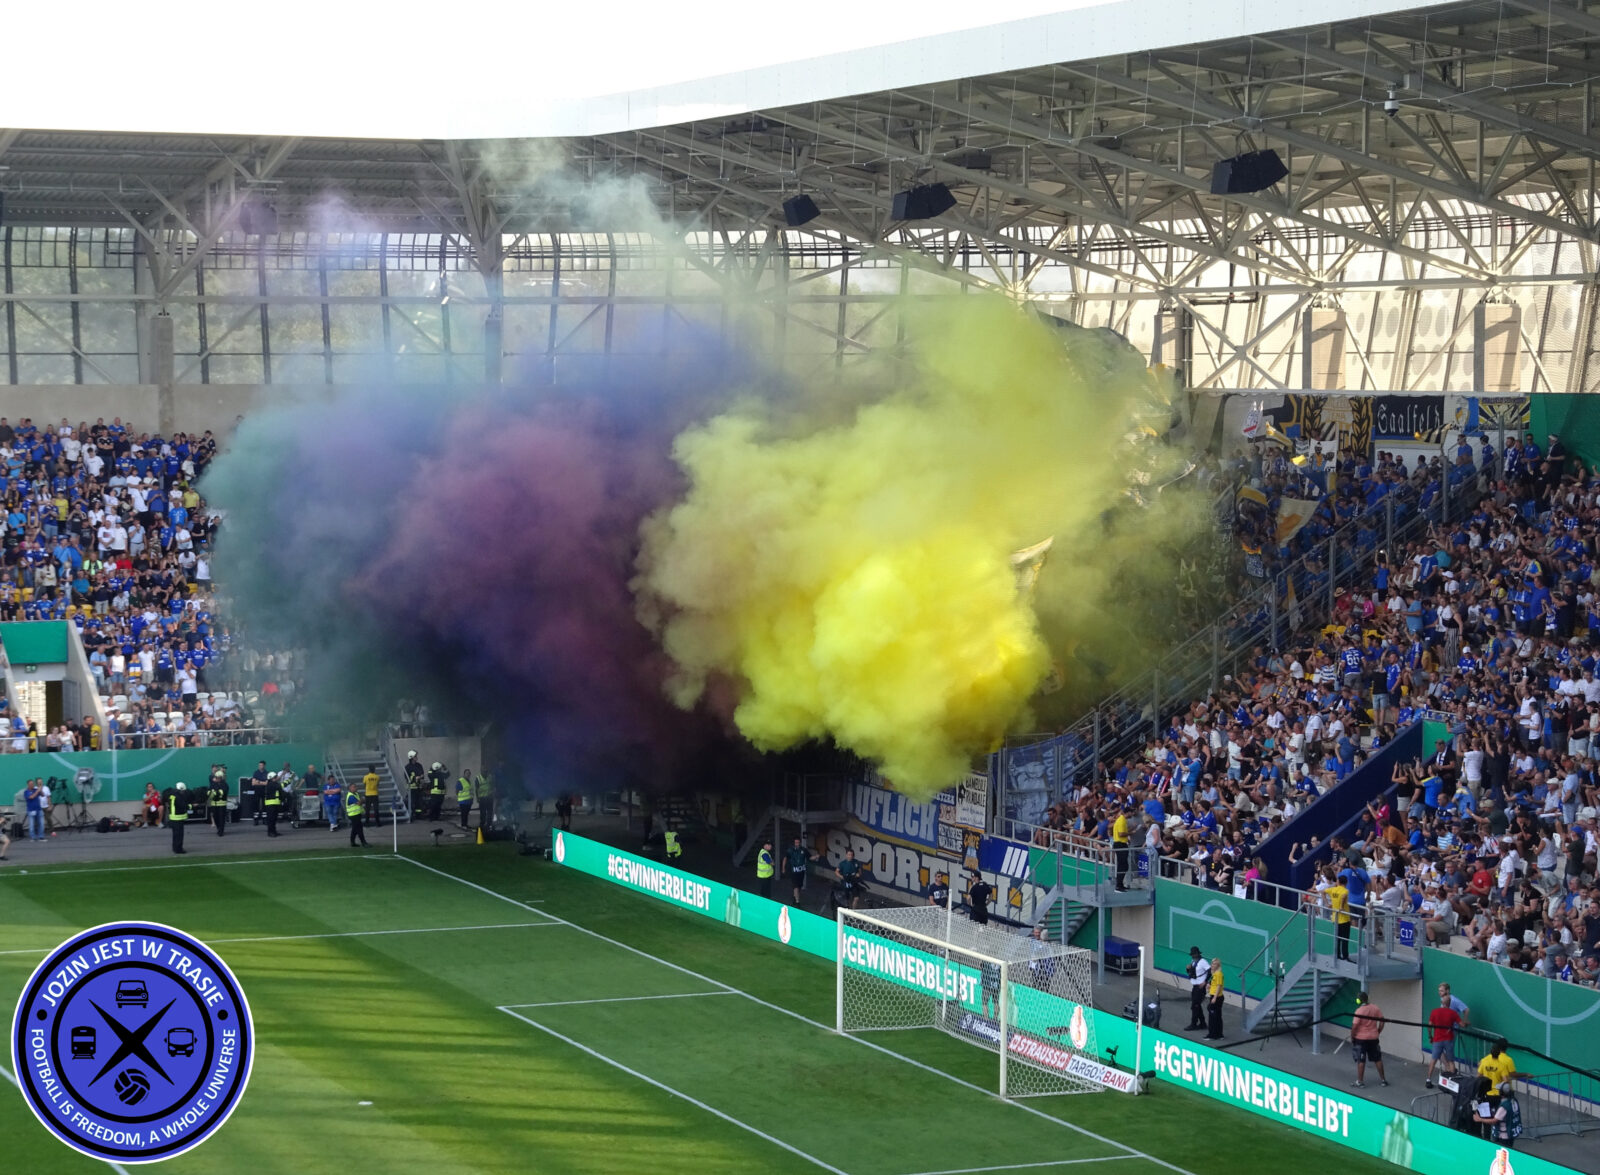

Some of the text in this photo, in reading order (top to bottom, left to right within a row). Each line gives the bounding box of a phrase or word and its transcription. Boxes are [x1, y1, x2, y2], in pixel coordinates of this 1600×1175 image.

[607, 853, 711, 910] #GEWINNERBLEIBT
[1400, 928, 1413, 940] C17
[1017, 1037, 1059, 1065] STRAUSS
[1153, 1040, 1353, 1137] #GEWINNERBLEIBT
